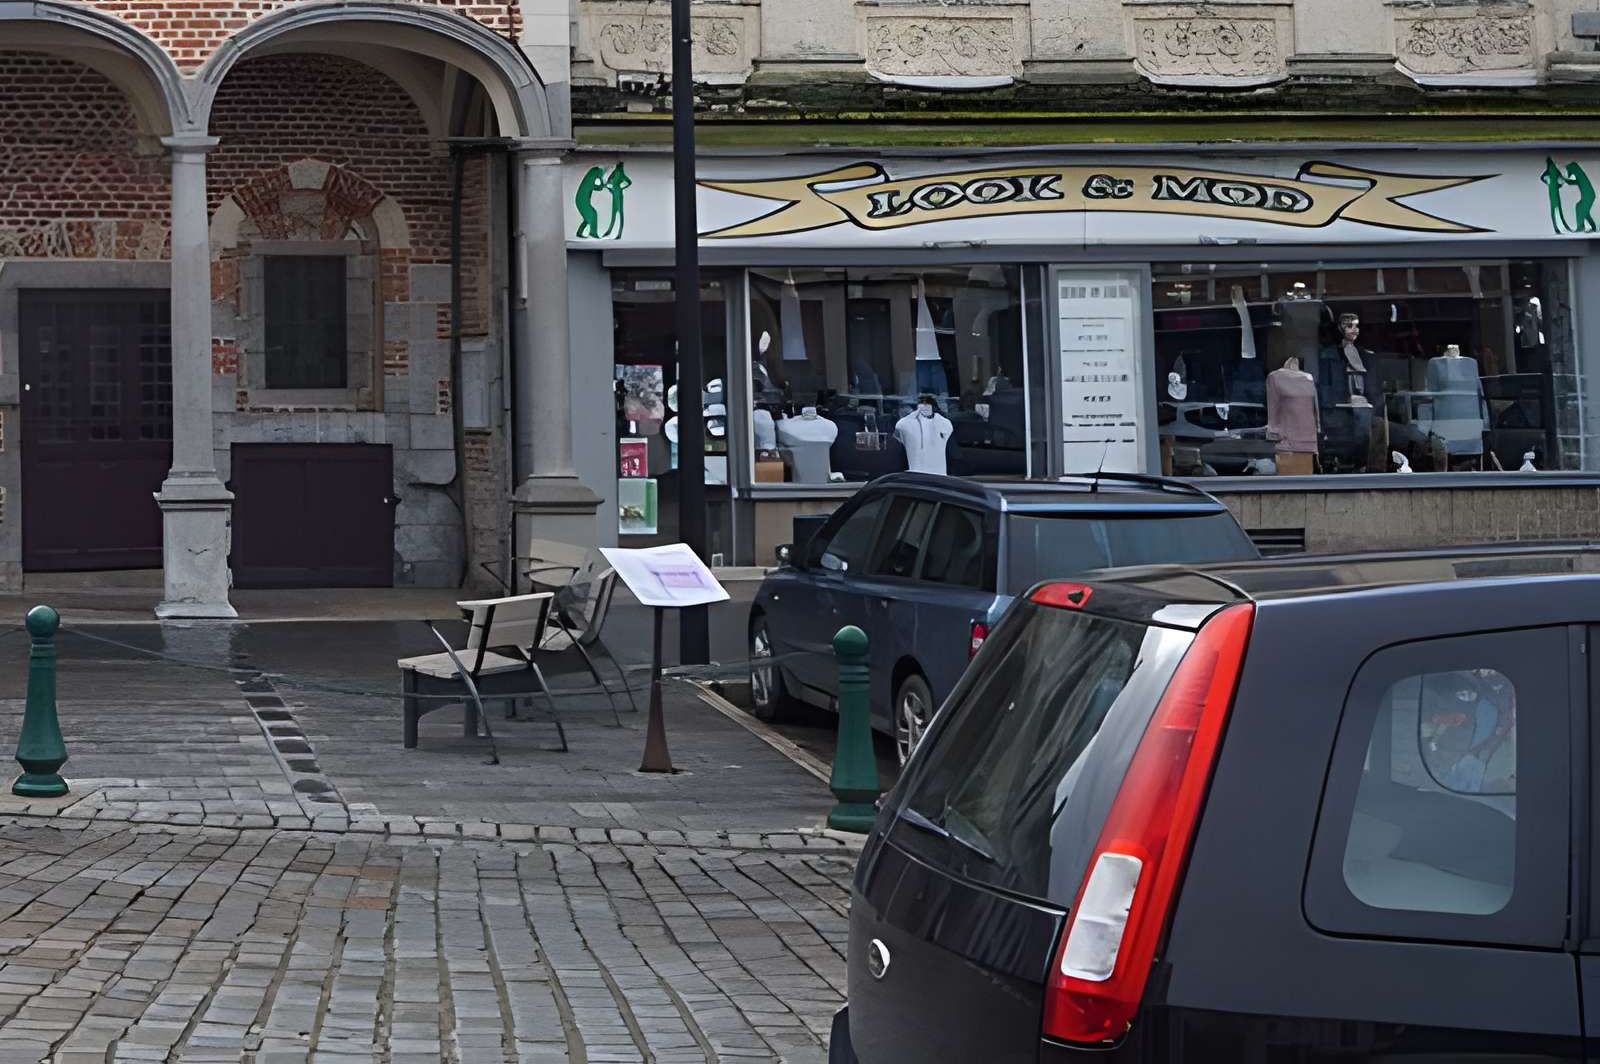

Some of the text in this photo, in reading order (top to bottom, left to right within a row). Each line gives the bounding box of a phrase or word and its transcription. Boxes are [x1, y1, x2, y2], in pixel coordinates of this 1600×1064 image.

[866, 173, 1314, 218] LOOK & MOD
